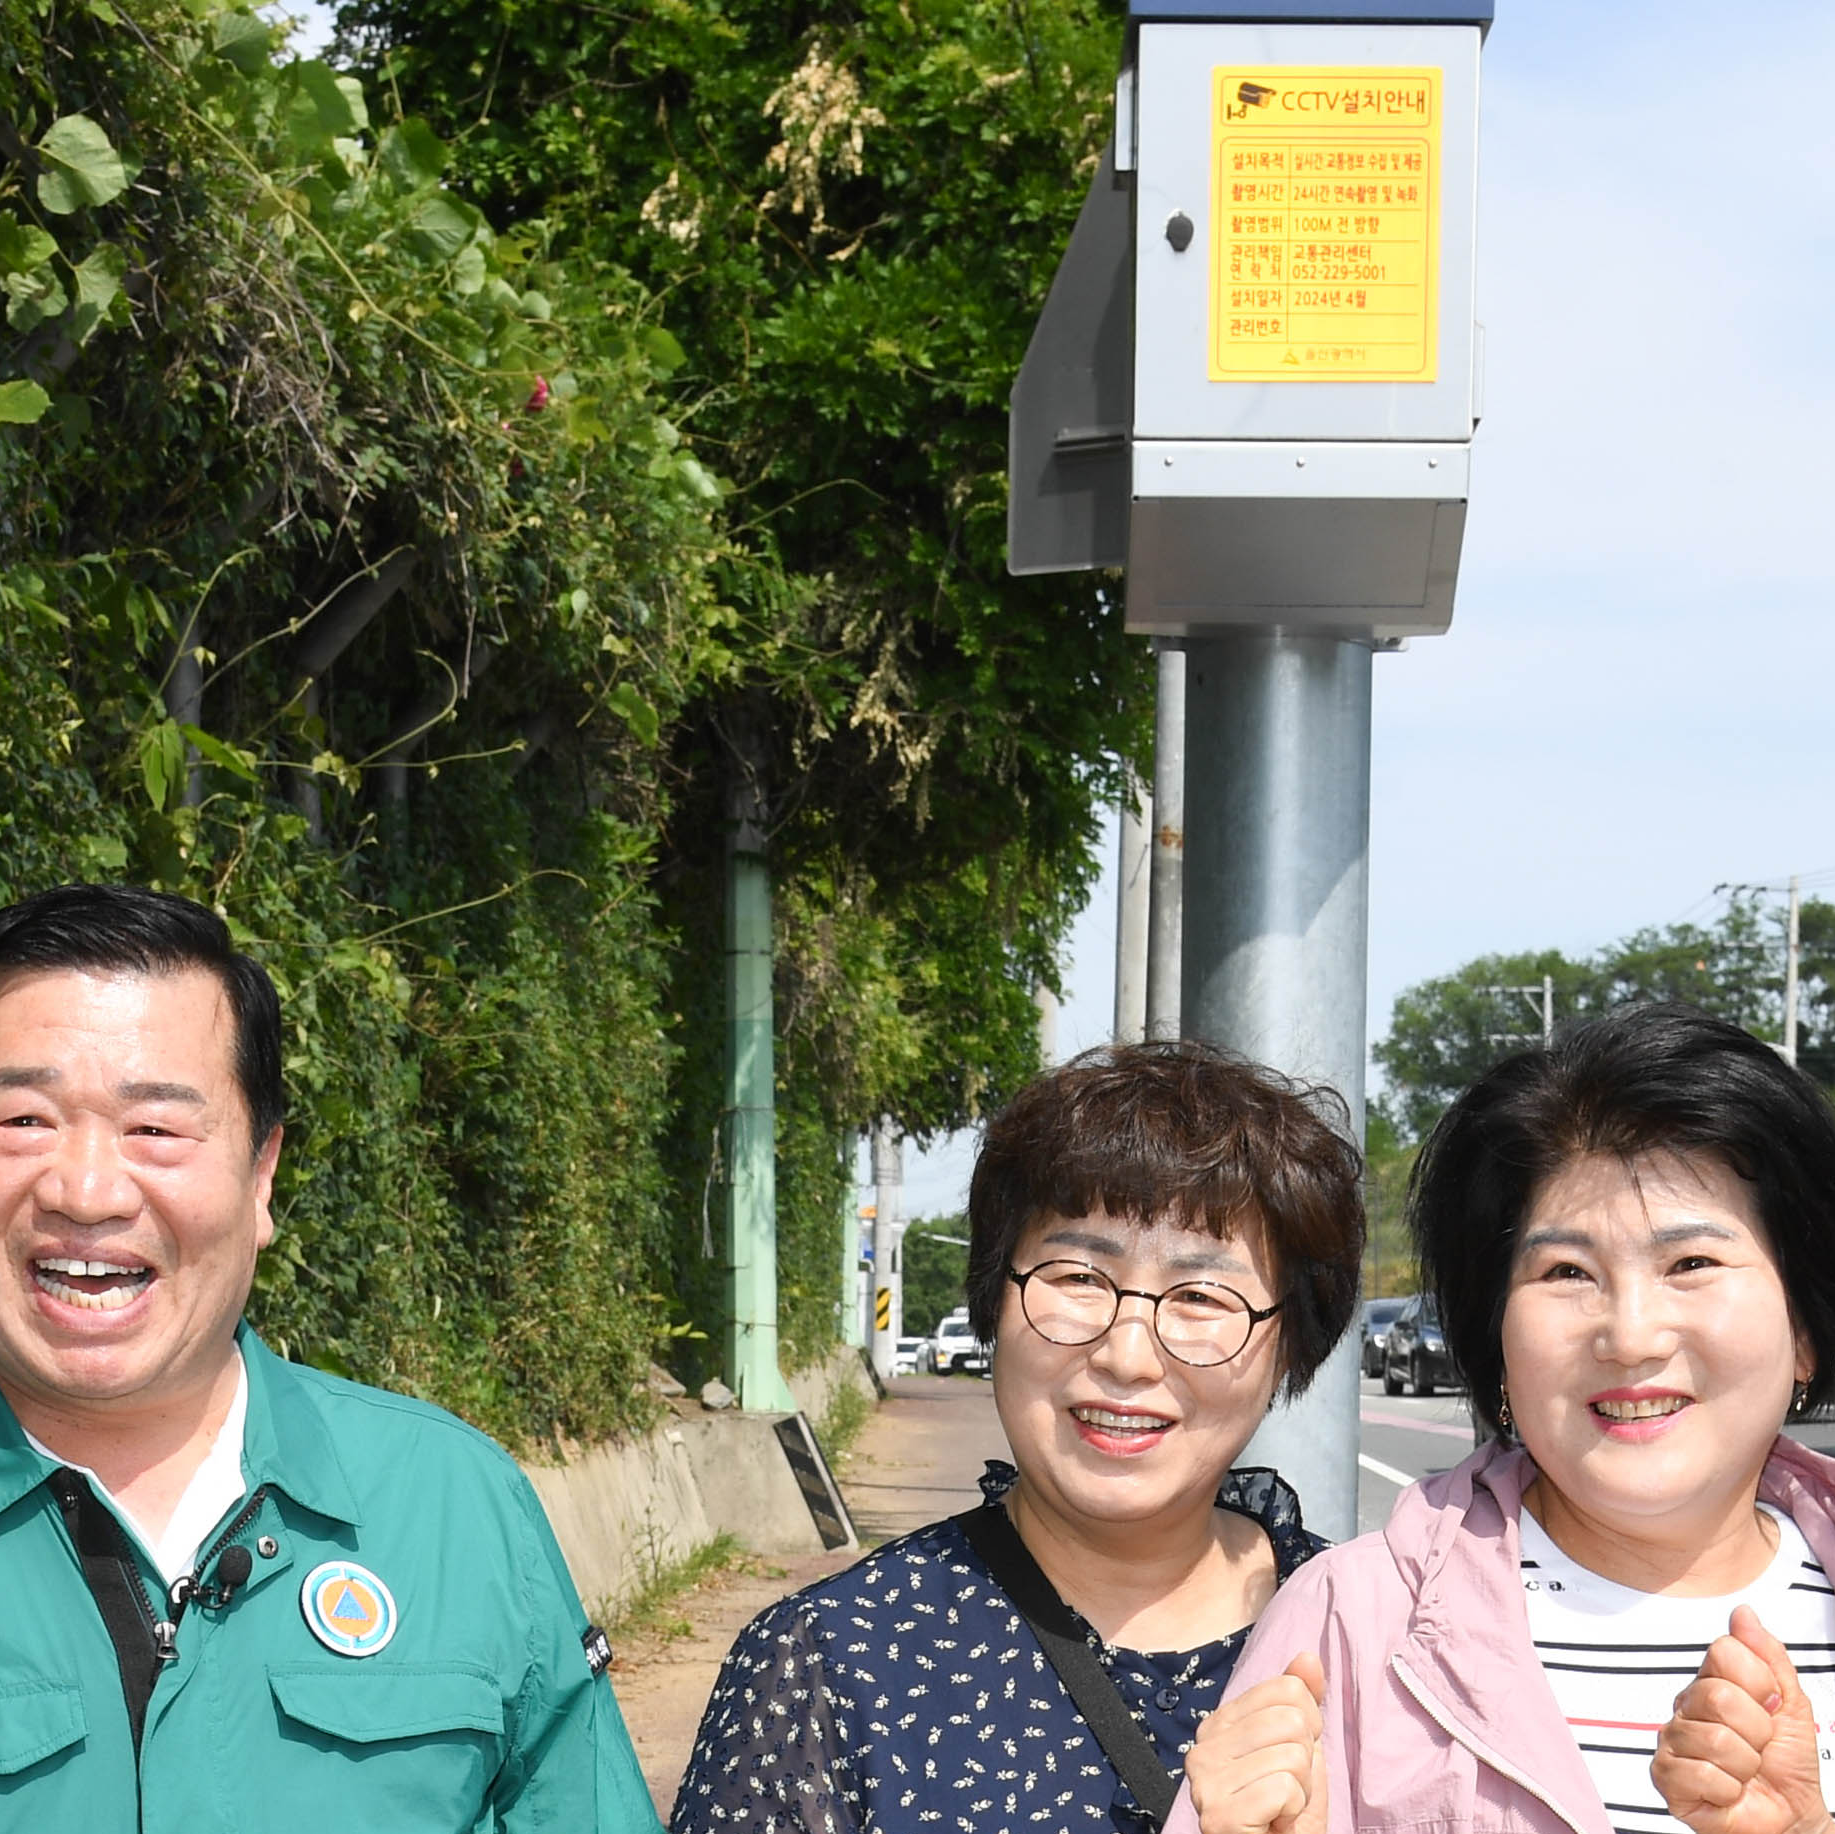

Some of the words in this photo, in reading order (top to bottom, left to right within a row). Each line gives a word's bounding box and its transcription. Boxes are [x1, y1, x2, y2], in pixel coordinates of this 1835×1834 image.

[1281, 89, 1426, 115] CCTV설치안내
[1232, 152, 1284, 171] 설치목적
[1326, 152, 1365, 171] 교통정보
[1391, 152, 1401, 171] 및
[1403, 152, 1423, 171] 제공
[1231, 184, 1284, 202] 촬영시간
[1294, 184, 1330, 203] 24시간
[1381, 184, 1393, 204] 및
[1231, 216, 1283, 234] 촬영범위
[1294, 217, 1332, 233] 100M
[1354, 216, 1380, 234] 방향
[1230, 244, 1283, 262] 관리책임
[1293, 244, 1372, 262] 교통관리센터
[1292, 265, 1387, 280] 052-229-5001
[1230, 289, 1282, 308] 설치일자
[1294, 290, 1342, 308] 2024년
[1345, 290, 1367, 309] 4월
[1230, 319, 1283, 337] 관리번호
